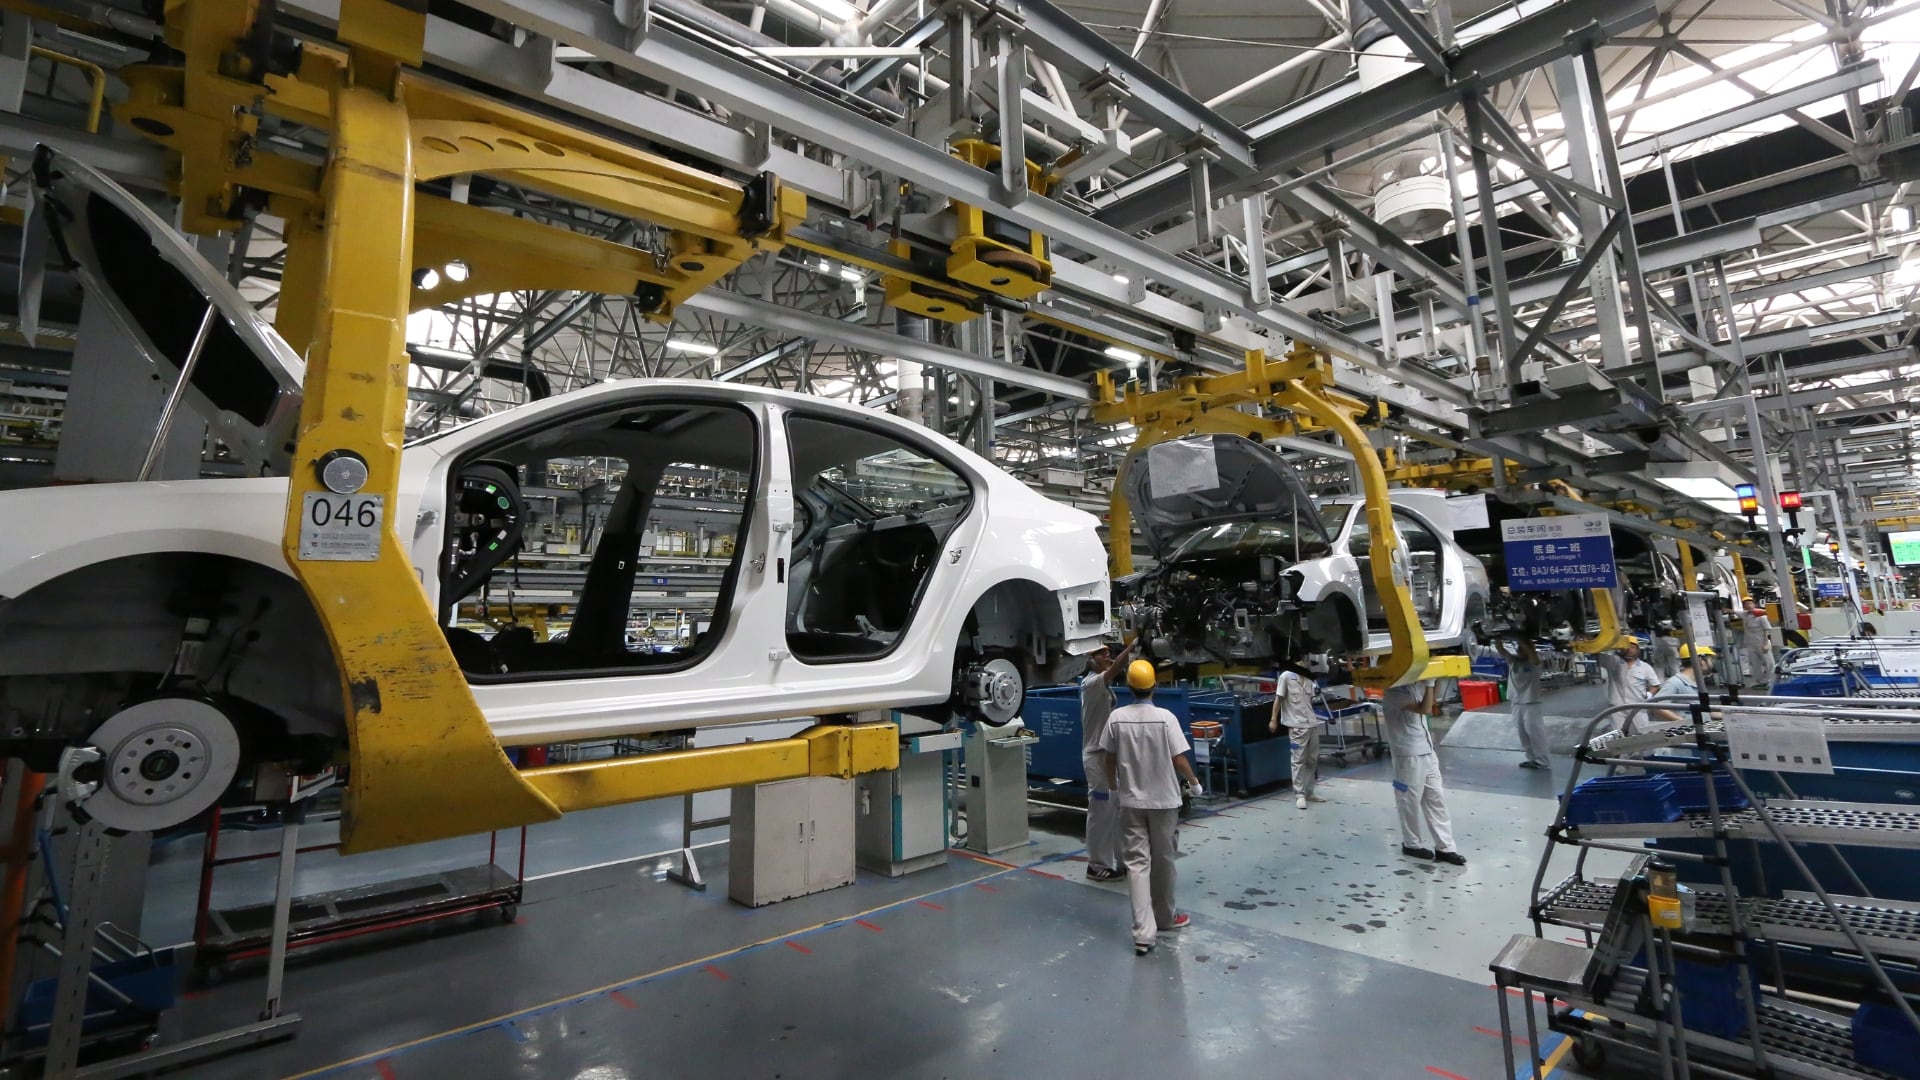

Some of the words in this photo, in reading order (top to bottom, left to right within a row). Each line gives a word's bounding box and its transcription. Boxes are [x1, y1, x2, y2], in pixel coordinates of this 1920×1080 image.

[311, 498, 376, 528] 046
[1533, 543, 1581, 554] 底盘一班
